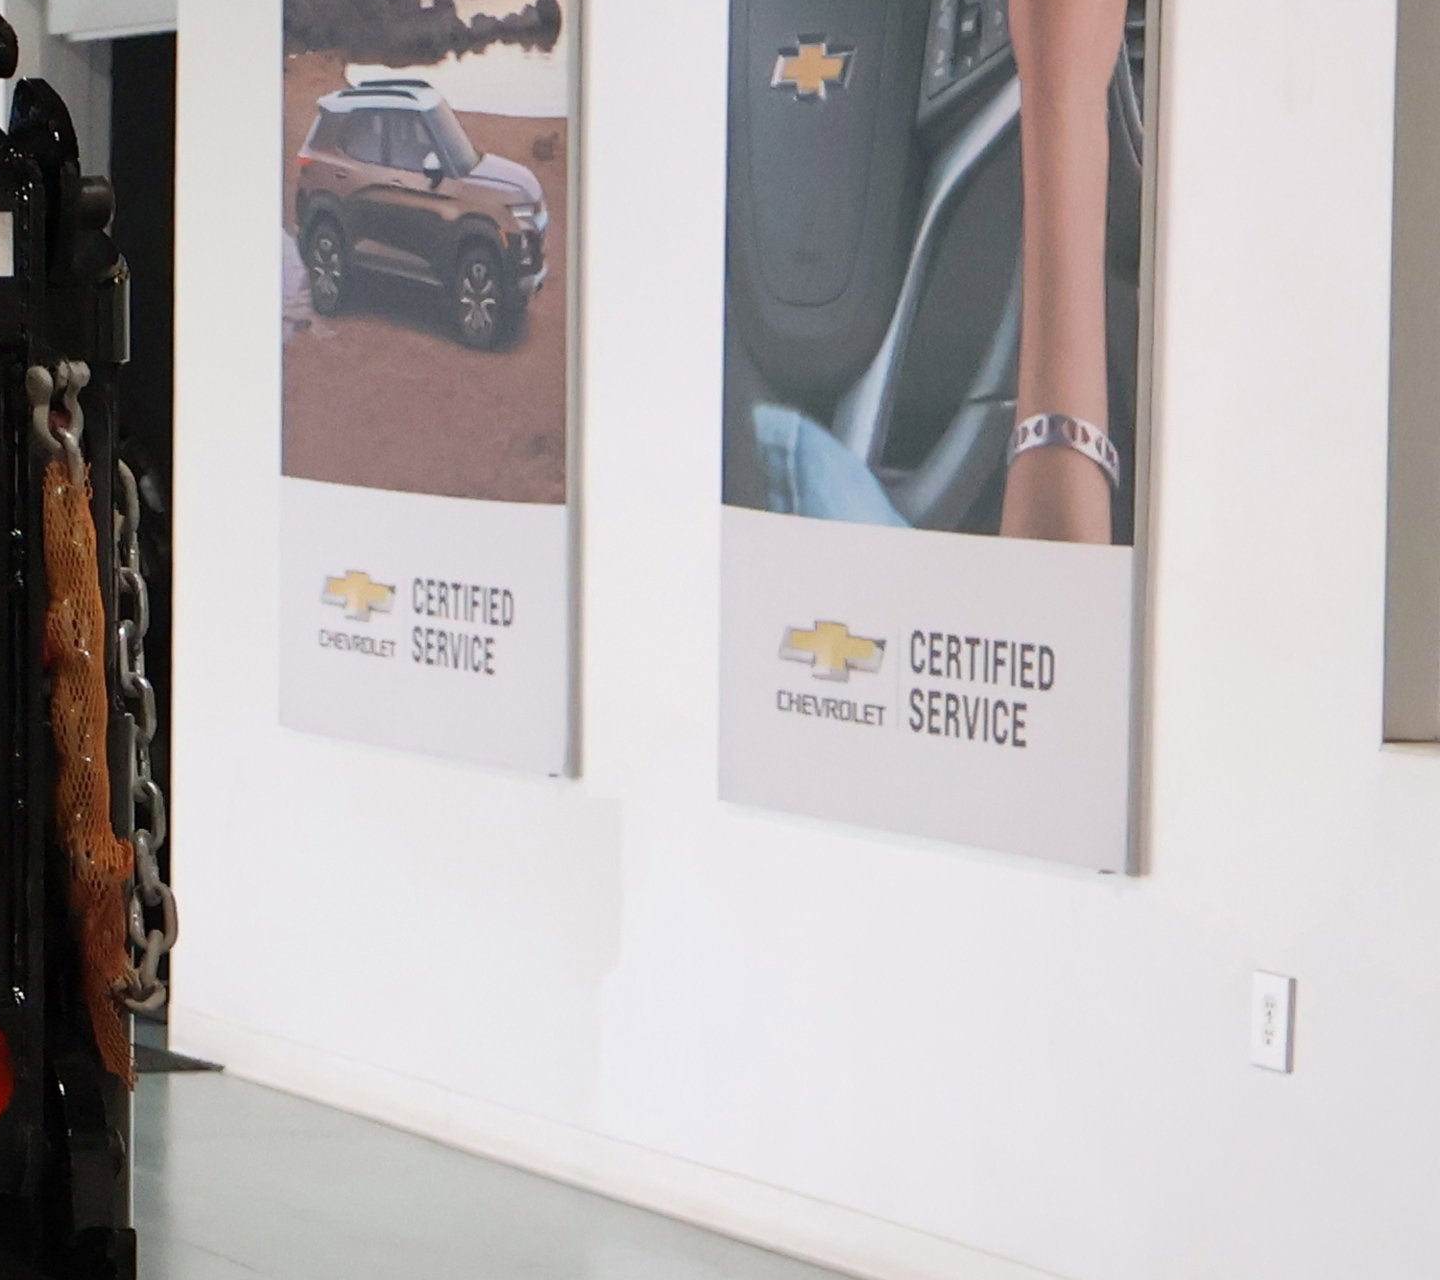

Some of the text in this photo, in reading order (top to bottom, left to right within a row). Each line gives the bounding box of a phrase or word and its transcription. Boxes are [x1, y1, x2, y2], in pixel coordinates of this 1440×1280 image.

[411, 577, 515, 629] CERTIFIED
[318, 628, 396, 660] CHEVROLET
[411, 625, 495, 677] SERVICE
[908, 629, 1056, 693] CERTIFIED
[776, 688, 885, 729] CHEVROLET
[908, 688, 1029, 750] SERVICE
